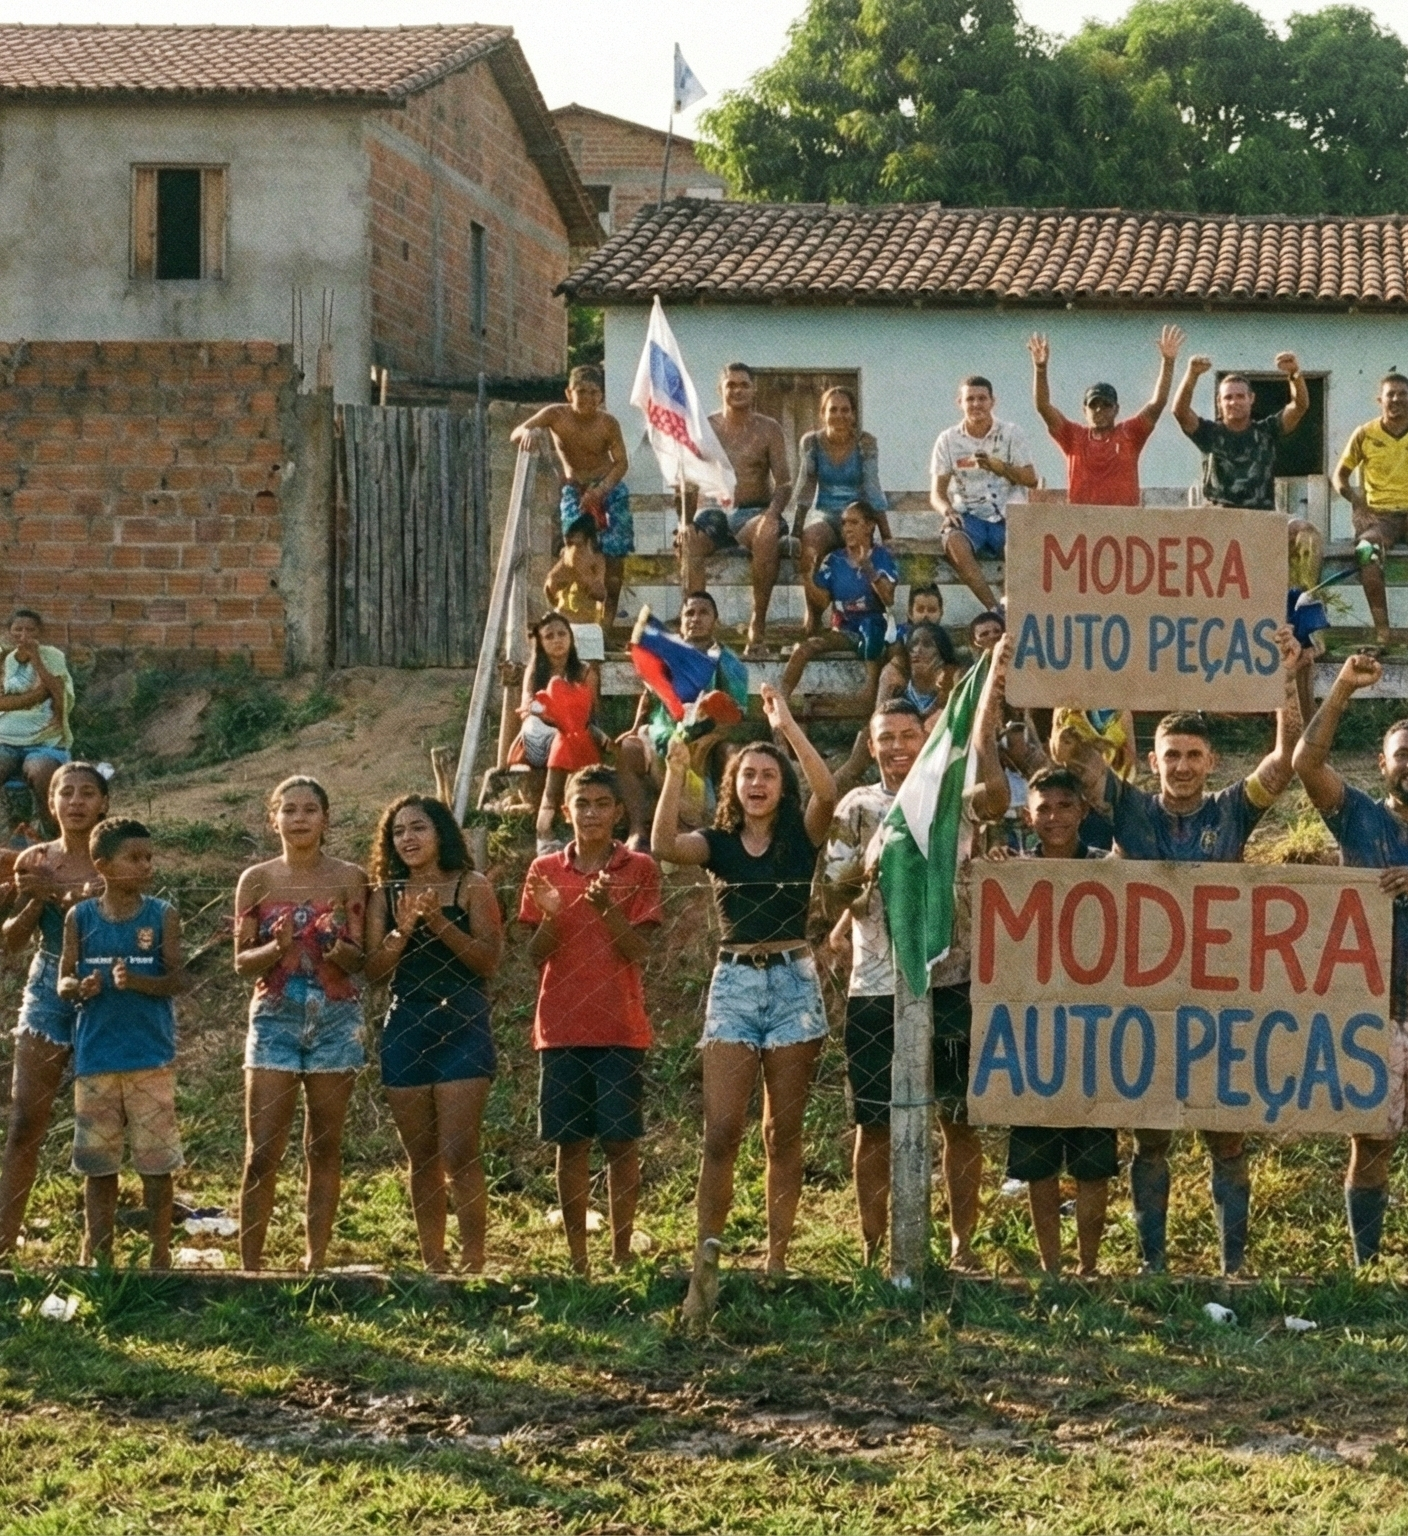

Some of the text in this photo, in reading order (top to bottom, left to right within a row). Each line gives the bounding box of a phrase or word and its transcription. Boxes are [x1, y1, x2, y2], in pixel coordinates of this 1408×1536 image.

[1041, 533, 1251, 600] MODERA
[1014, 613, 1281, 682] AUTO PEÇAS
[978, 879, 1385, 996] MODERA
[972, 1003, 1390, 1123] AUTO PEÇAS
